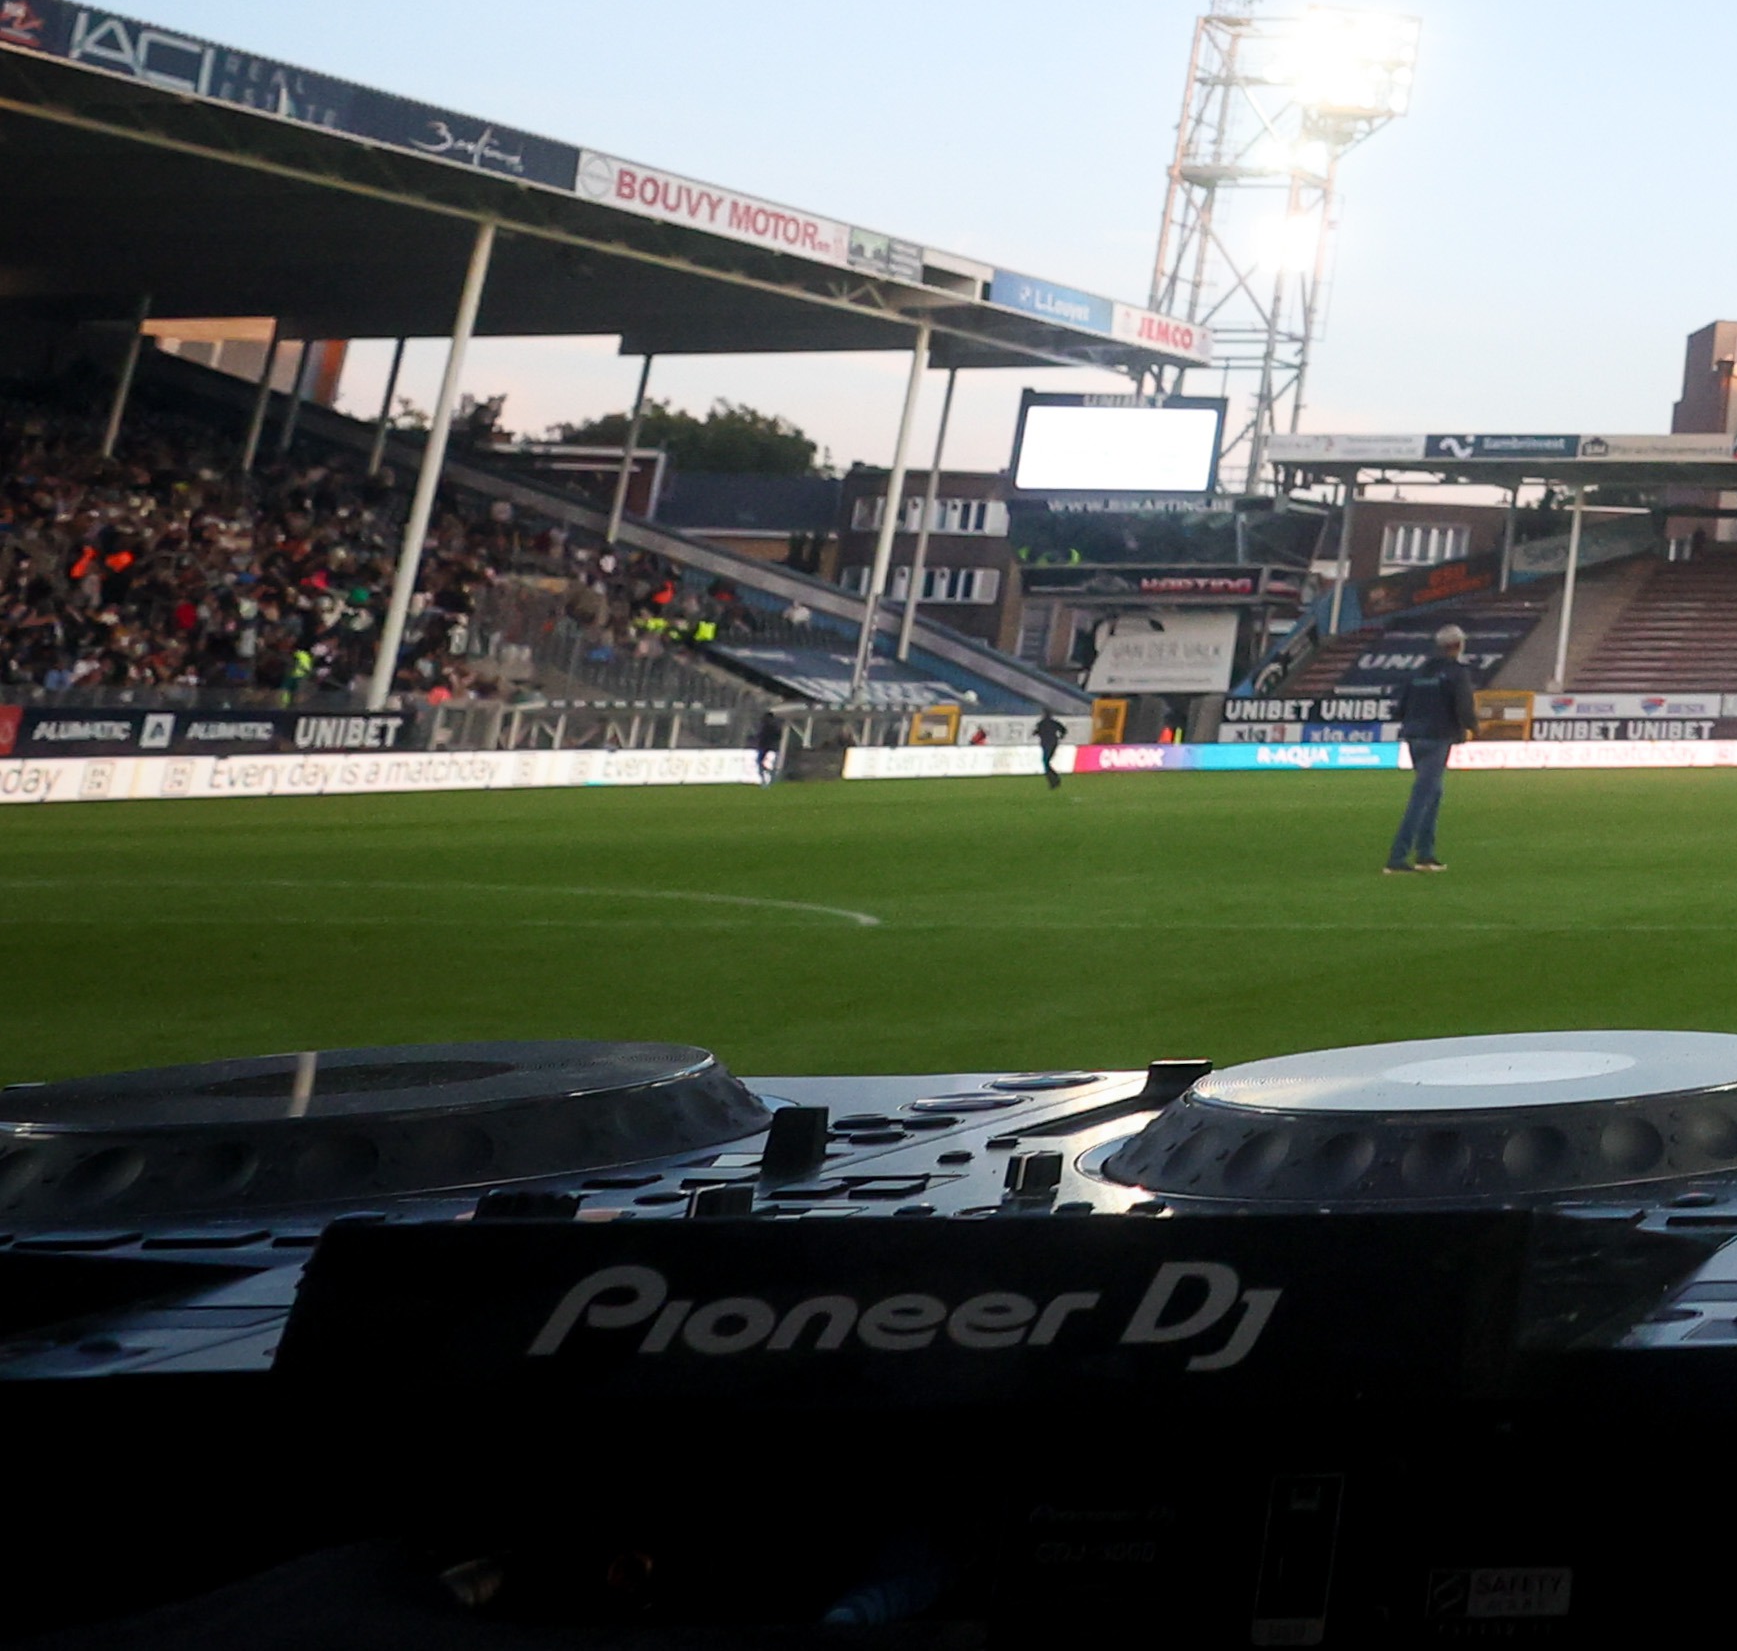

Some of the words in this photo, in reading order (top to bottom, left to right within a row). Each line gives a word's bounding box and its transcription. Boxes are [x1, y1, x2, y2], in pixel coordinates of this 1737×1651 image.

[615, 167, 723, 222] BOUVY
[729, 201, 818, 250] MOTOR
[1137, 316, 1193, 350] JEMCO
[1225, 699, 1314, 721] UNIBET
[295, 717, 403, 748] UNIBET
[1532, 720, 1620, 740] UNIBET
[1627, 720, 1715, 740] UNIBET
[1515, 745, 1553, 765] day
[1597, 743, 1697, 764] matchday
[0, 761, 62, 795] day
[209, 758, 284, 792] Every
[287, 758, 333, 789] day
[339, 758, 360, 784] is
[385, 753, 498, 784] matchday
[525, 1265, 1101, 1356] Pioneer
[1119, 1260, 1283, 1371] DJ
